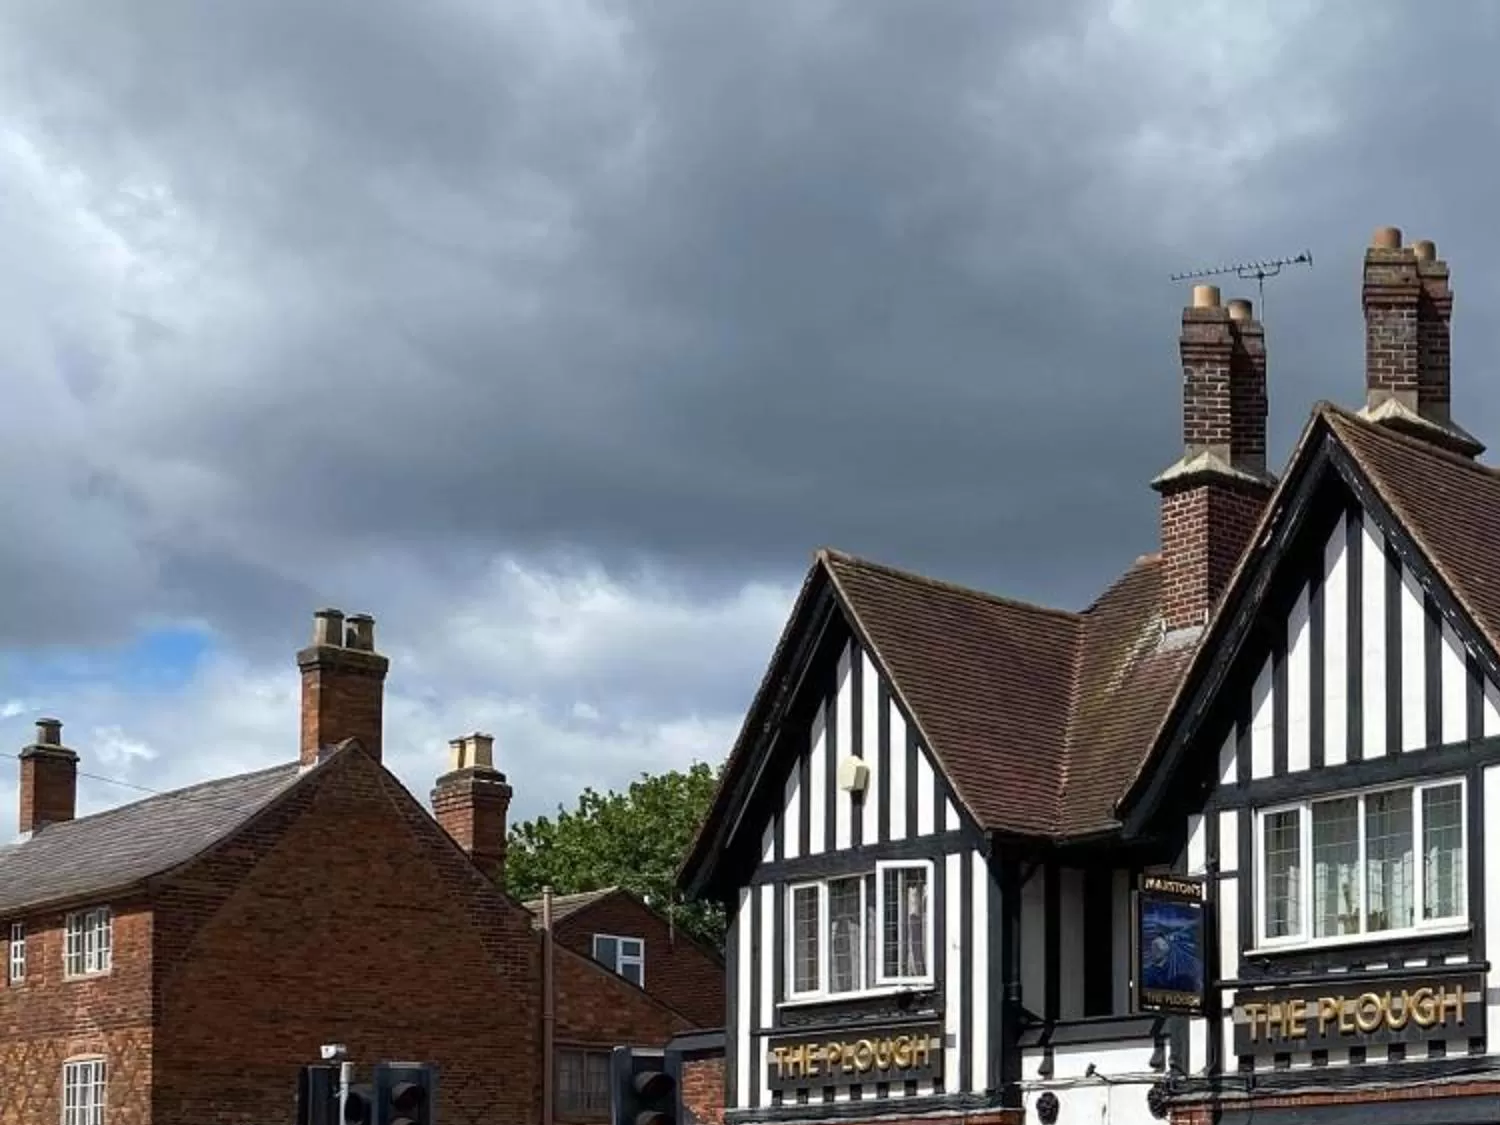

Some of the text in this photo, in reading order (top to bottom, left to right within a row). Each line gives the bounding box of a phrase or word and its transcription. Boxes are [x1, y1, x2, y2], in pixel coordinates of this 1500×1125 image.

[1244, 983, 1466, 1042] THE PLOUGH
[773, 1033, 930, 1080] THE PLOUGH
